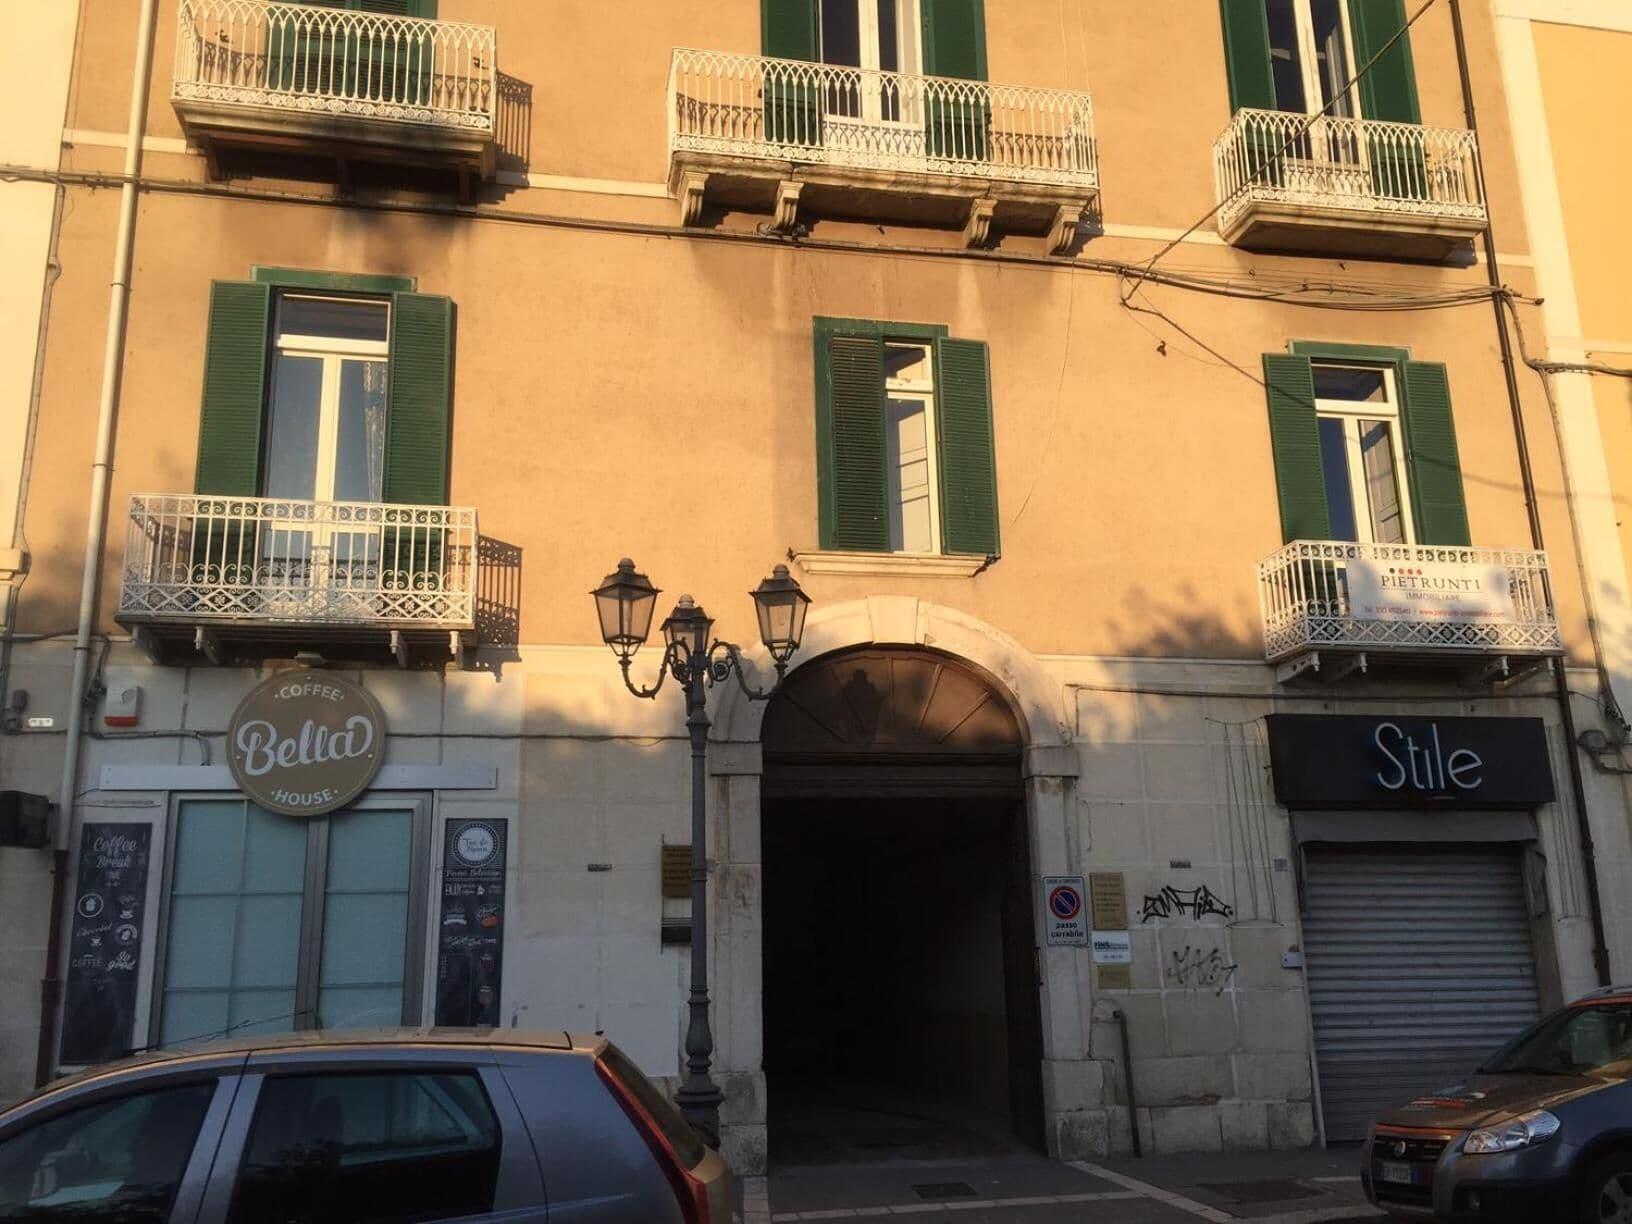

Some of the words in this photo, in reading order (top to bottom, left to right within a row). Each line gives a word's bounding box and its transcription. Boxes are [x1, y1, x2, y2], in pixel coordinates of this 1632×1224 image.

[1381, 575, 1481, 590] PIETRUNTI
[1406, 592, 1461, 602] IMMOBILIARE
[279, 684, 341, 701] COFFEE
[237, 715, 373, 776] Bella
[1374, 722, 1483, 790] Stile
[274, 788, 333, 806] HOUSE
[94, 835, 137, 857] Coffee
[1051, 930, 1084, 939] carrabile
[1056, 922, 1078, 930] passo
